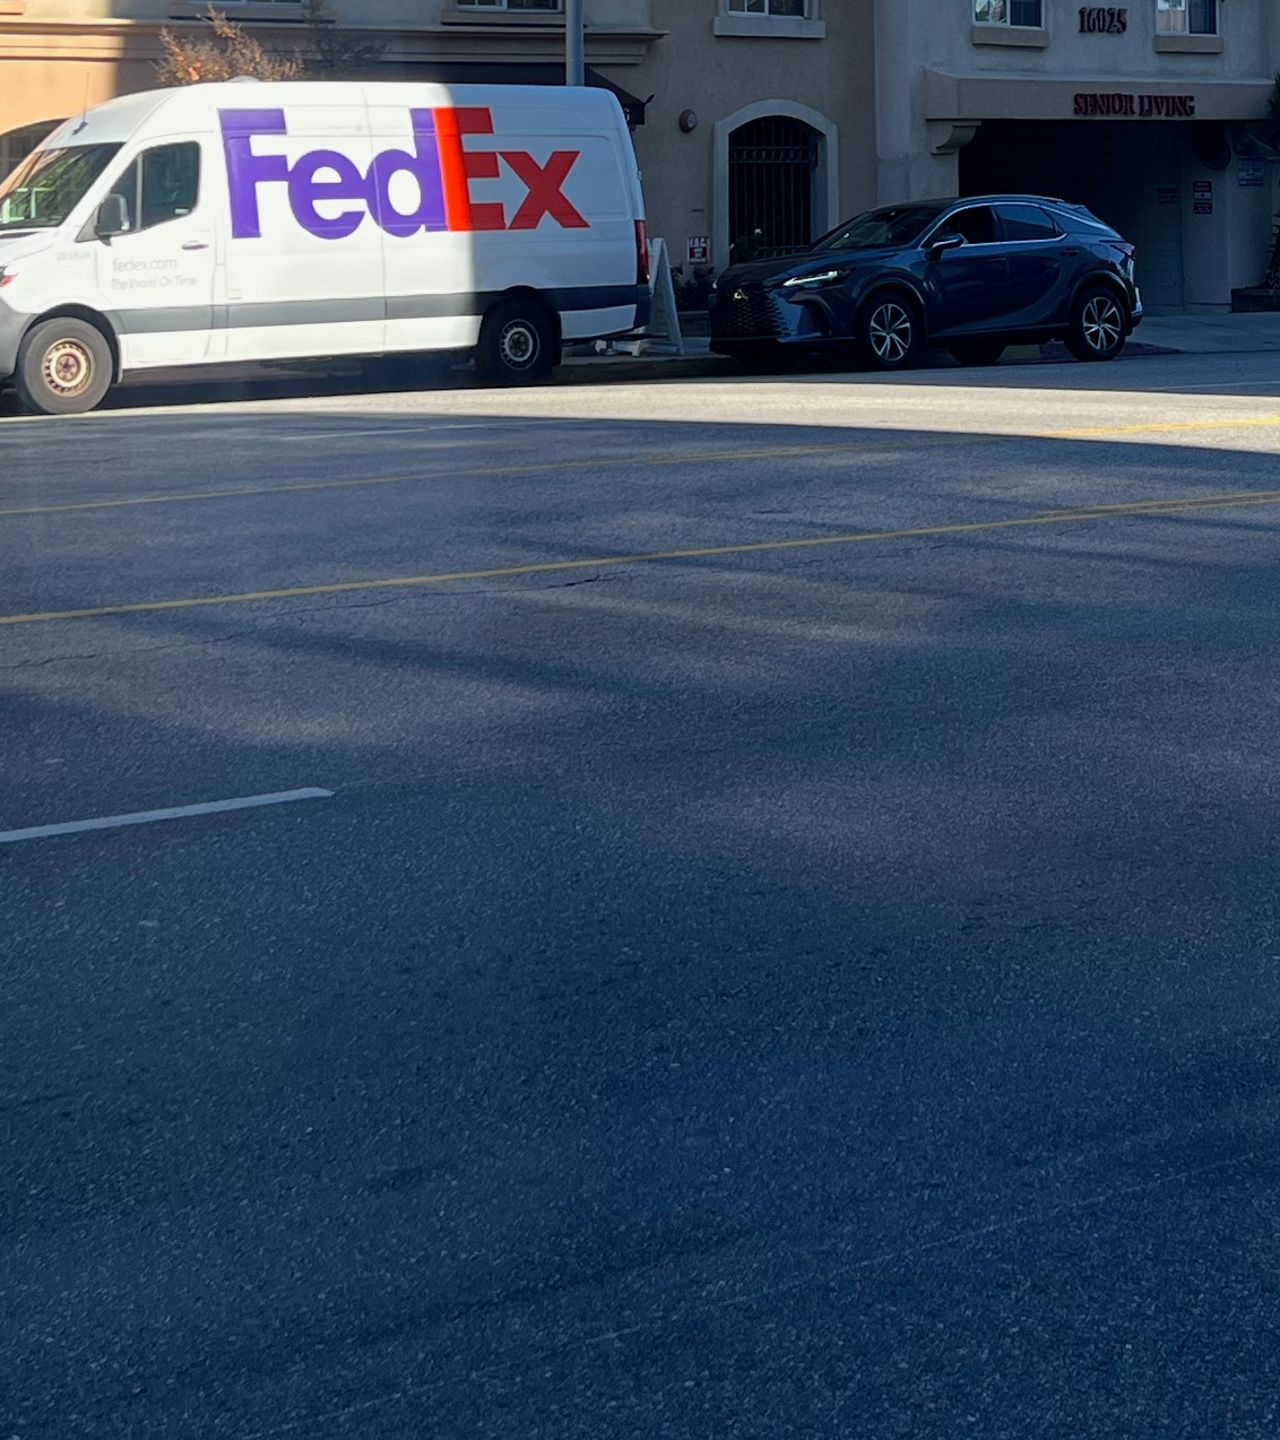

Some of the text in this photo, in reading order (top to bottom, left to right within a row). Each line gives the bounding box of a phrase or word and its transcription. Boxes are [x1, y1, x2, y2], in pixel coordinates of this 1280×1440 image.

[1078, 7, 1128, 33] 16025
[1074, 93, 1196, 116] SENIOR LIVING
[219, 107, 589, 239] FedEx
[112, 257, 177, 272] fedex.com
[159, 275, 173, 287] On
